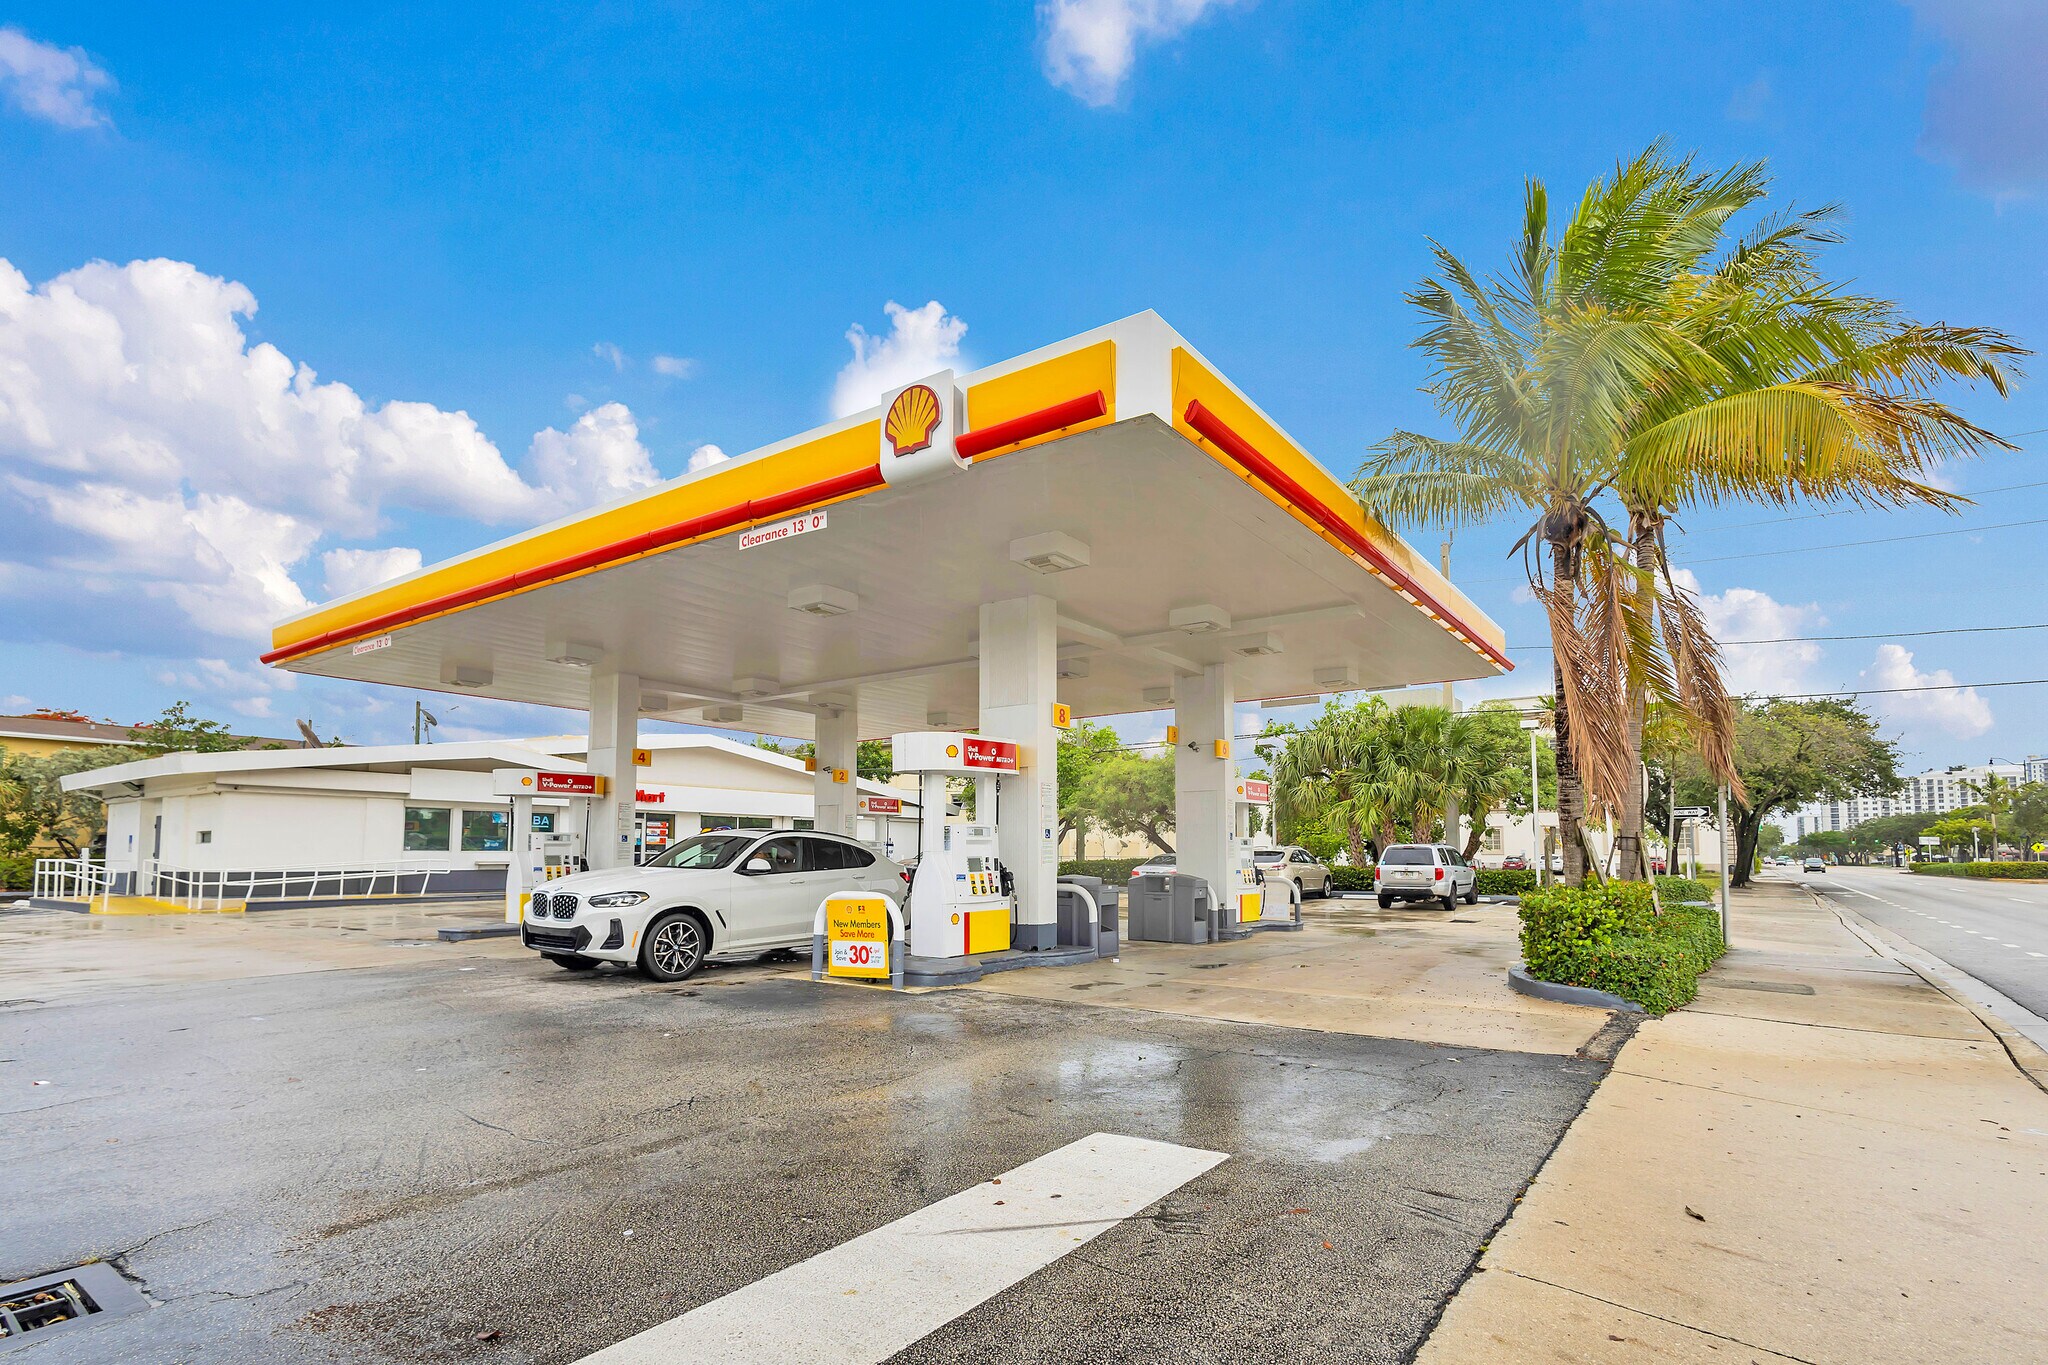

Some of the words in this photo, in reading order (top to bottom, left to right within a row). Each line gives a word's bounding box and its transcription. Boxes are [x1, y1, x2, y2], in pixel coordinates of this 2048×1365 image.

[741, 527, 788, 547] Clearance
[792, 518, 807, 534] 13'
[812, 515, 825, 529] 0"
[1059, 708, 1066, 724] 8
[1222, 744, 1226, 754] 6
[638, 752, 646, 762] 4
[967, 751, 996, 762] V-Power
[839, 771, 845, 781] 2
[542, 781, 572, 789] V-Power
[833, 920, 848, 928] New
[850, 918, 881, 928] Members
[840, 929, 855, 938] Save
[857, 930, 875, 939] More
